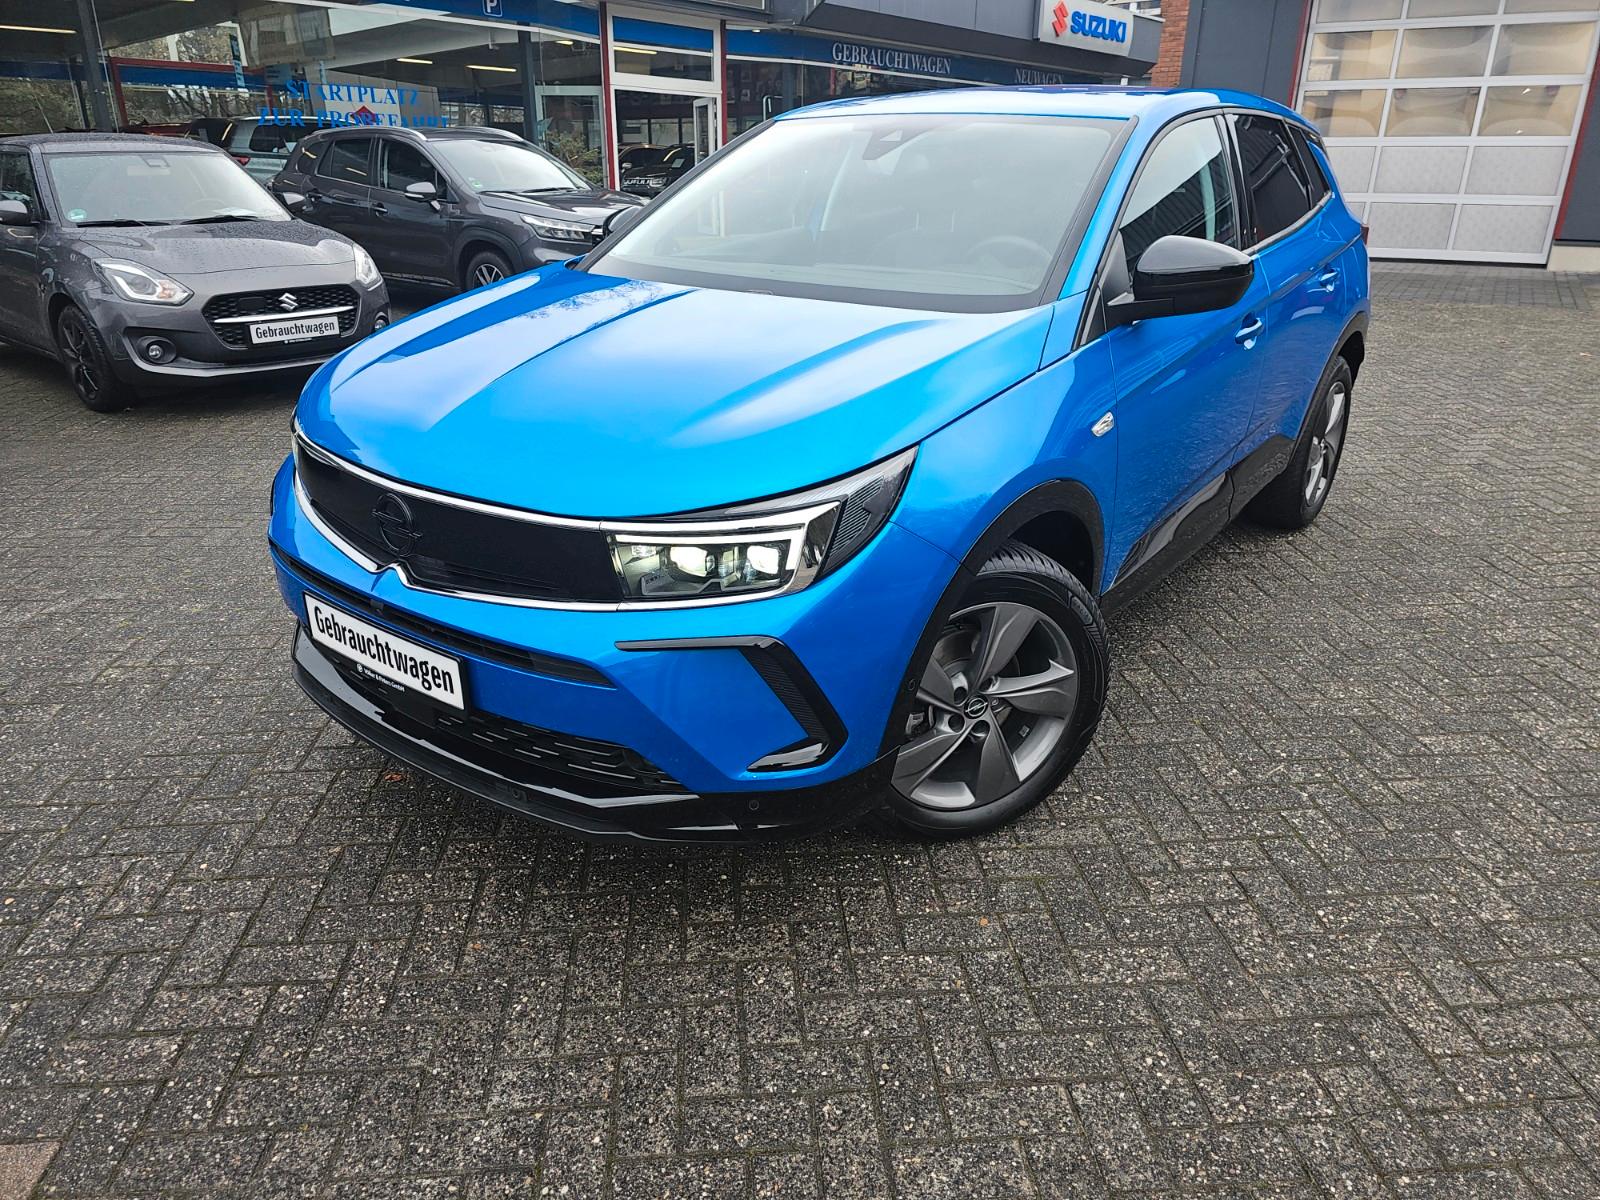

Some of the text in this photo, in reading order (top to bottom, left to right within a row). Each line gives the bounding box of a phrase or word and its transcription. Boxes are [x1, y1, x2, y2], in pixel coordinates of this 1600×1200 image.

[485, 0, 498, 13] P
[1071, 11, 1127, 43] SUZUKI
[832, 42, 951, 75] GEBRAUCHTWAGEN
[1014, 68, 1064, 85] NEUWAGEN
[286, 79, 418, 105] STARTPLATZ
[257, 105, 306, 128] ZUR
[255, 321, 336, 339] Gebrauchtwagen
[314, 606, 455, 695] Gebrauchtwagen
